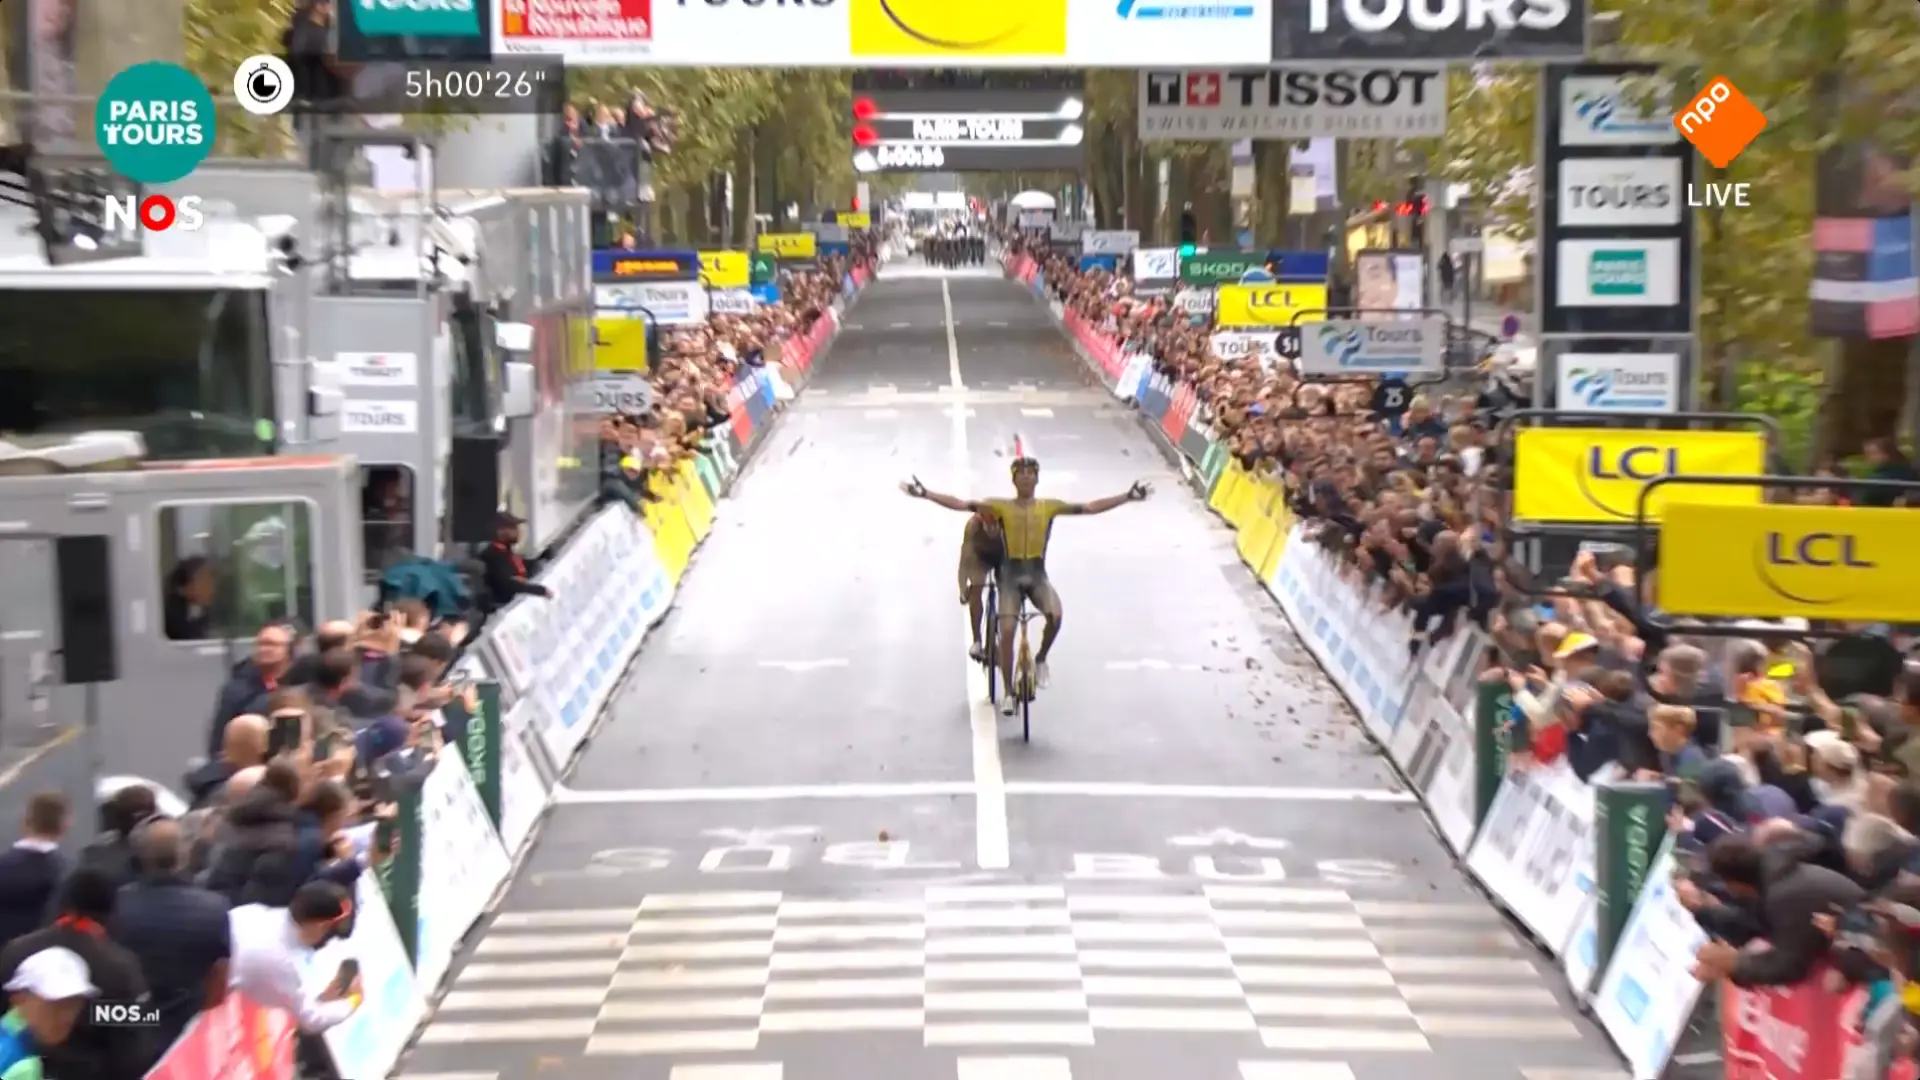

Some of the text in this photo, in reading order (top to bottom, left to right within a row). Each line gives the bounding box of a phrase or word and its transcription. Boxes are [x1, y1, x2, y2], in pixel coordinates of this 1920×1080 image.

[1228, 69, 1439, 107] TISSOT
[1569, 184, 1671, 209] TOURS
[1251, 290, 1299, 308] LCL
[1366, 326, 1424, 343] Tours
[1766, 532, 1878, 568] LCL
